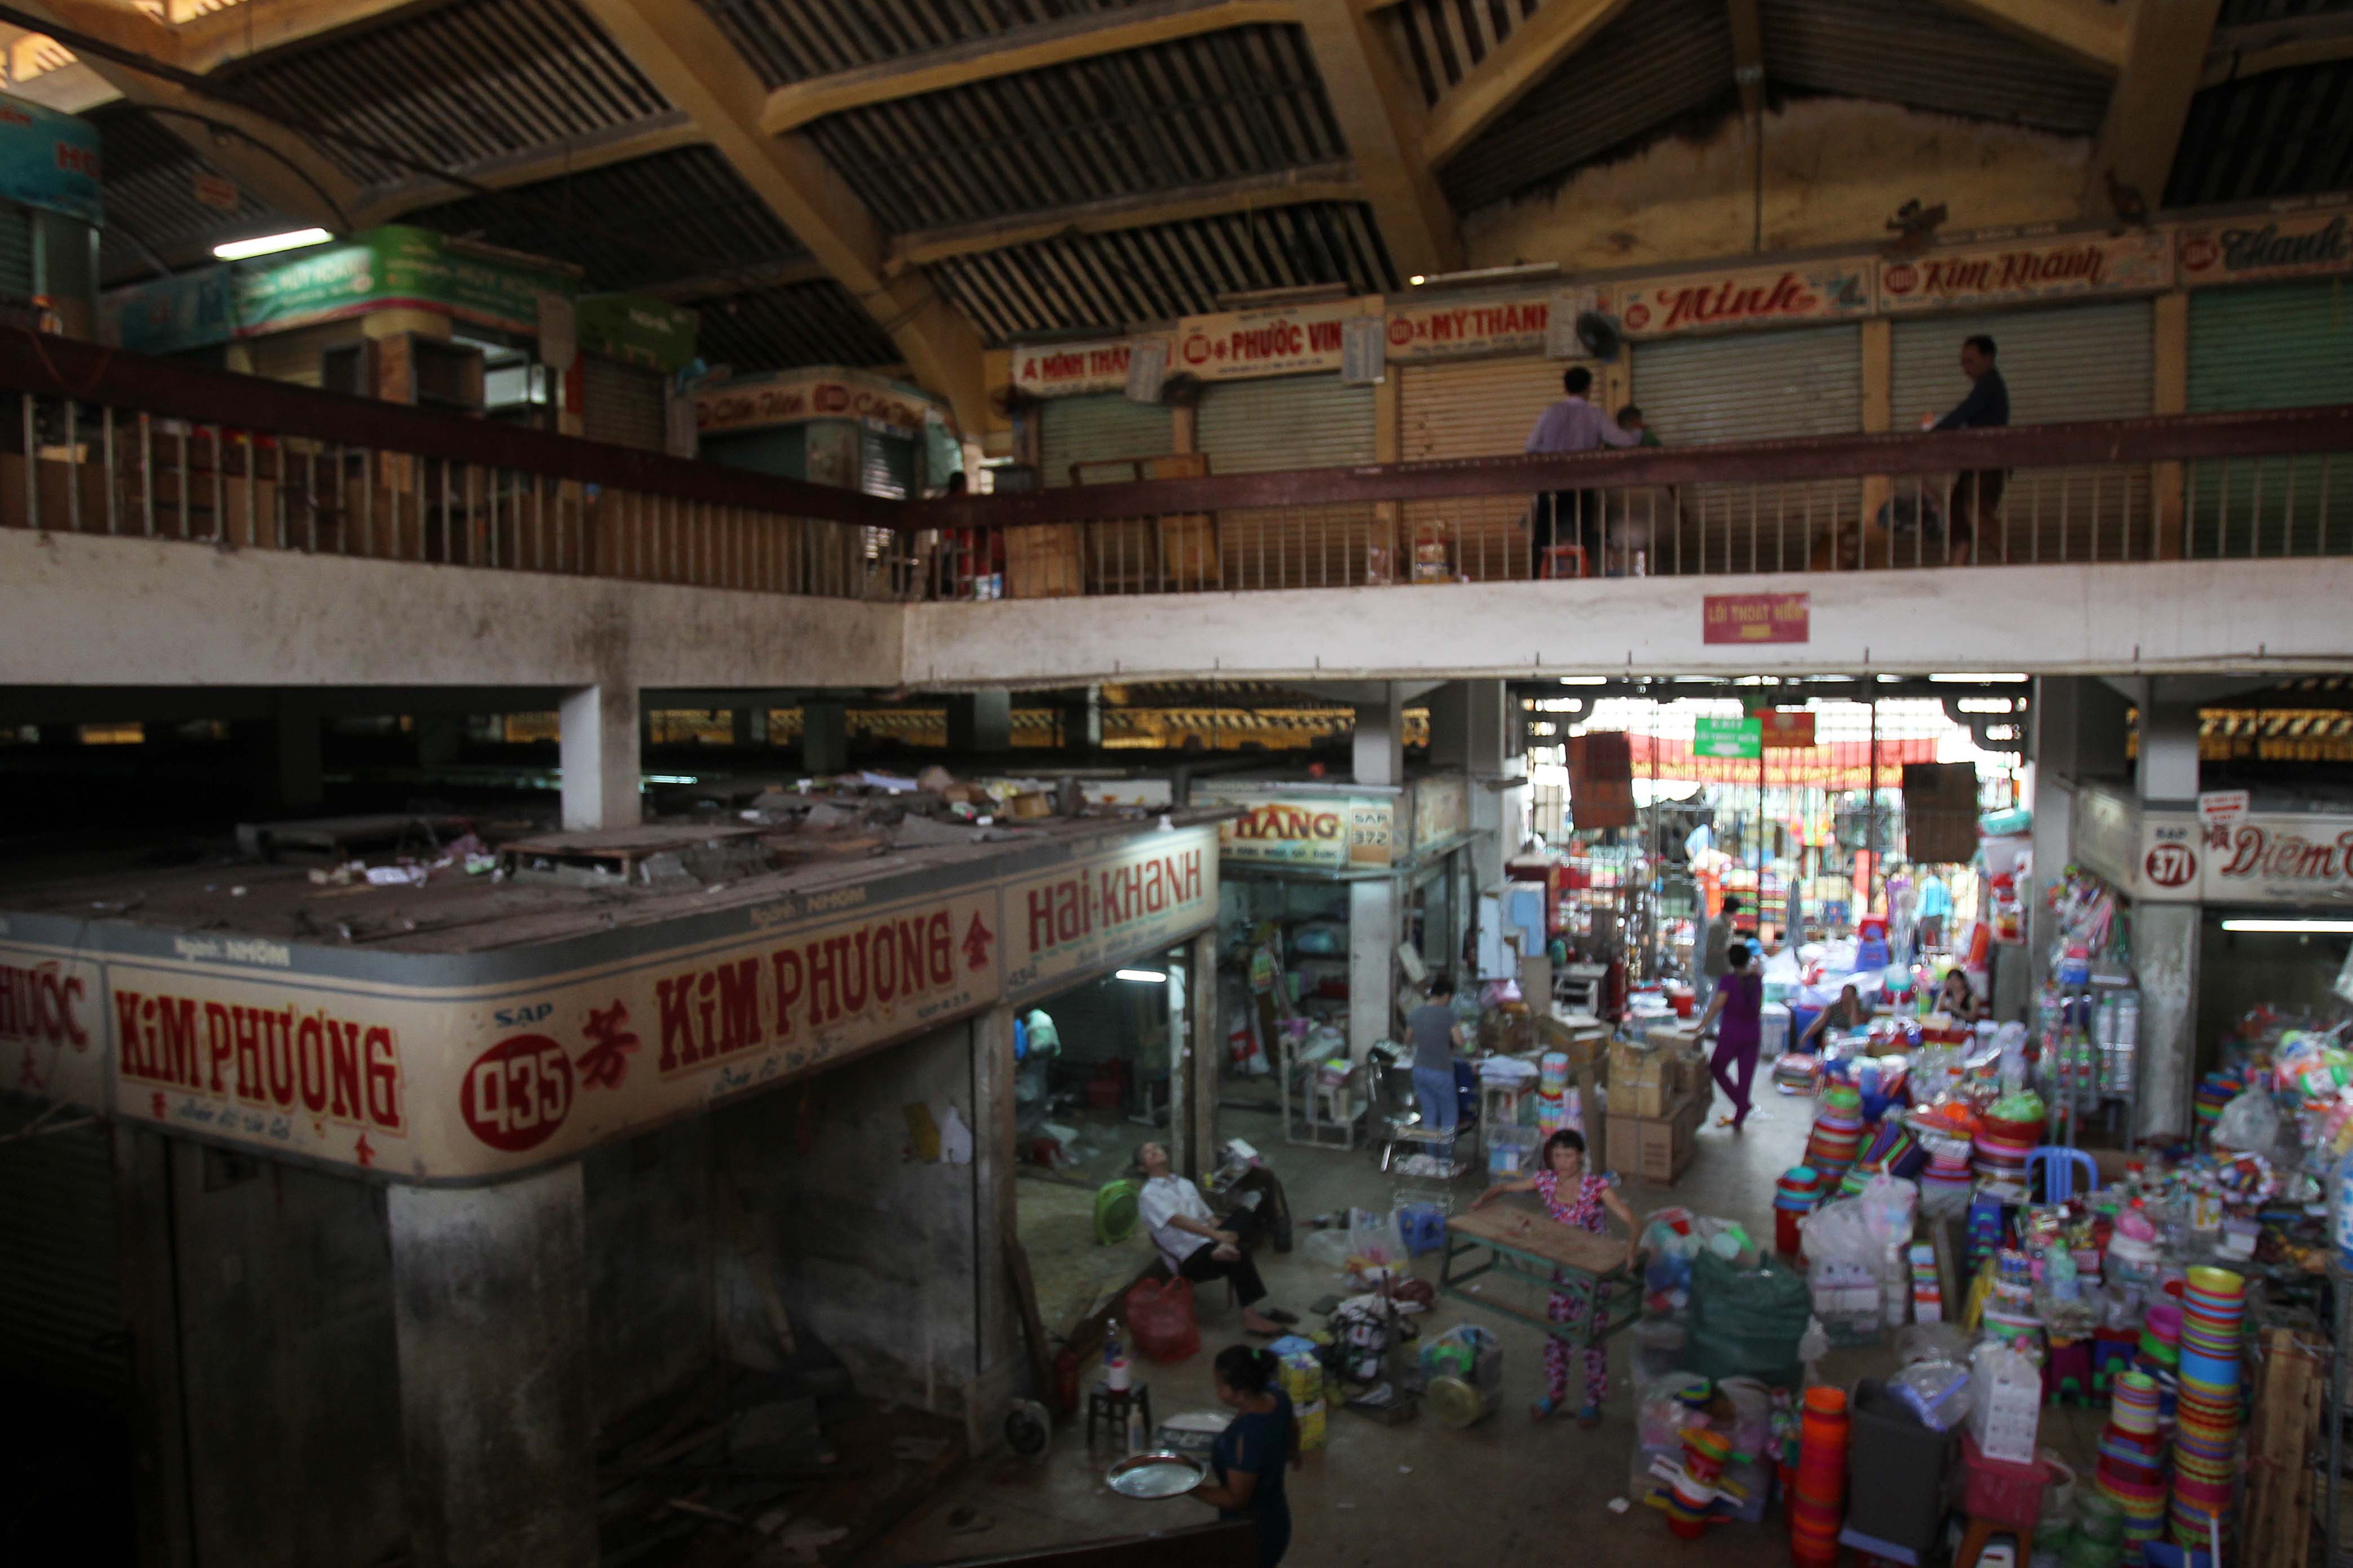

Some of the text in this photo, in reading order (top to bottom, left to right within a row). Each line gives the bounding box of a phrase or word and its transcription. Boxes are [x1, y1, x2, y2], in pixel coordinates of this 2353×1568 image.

[1308, 319, 1342, 353] VIN
[1352, 829, 1388, 845] 372
[2151, 849, 2190, 882] 371
